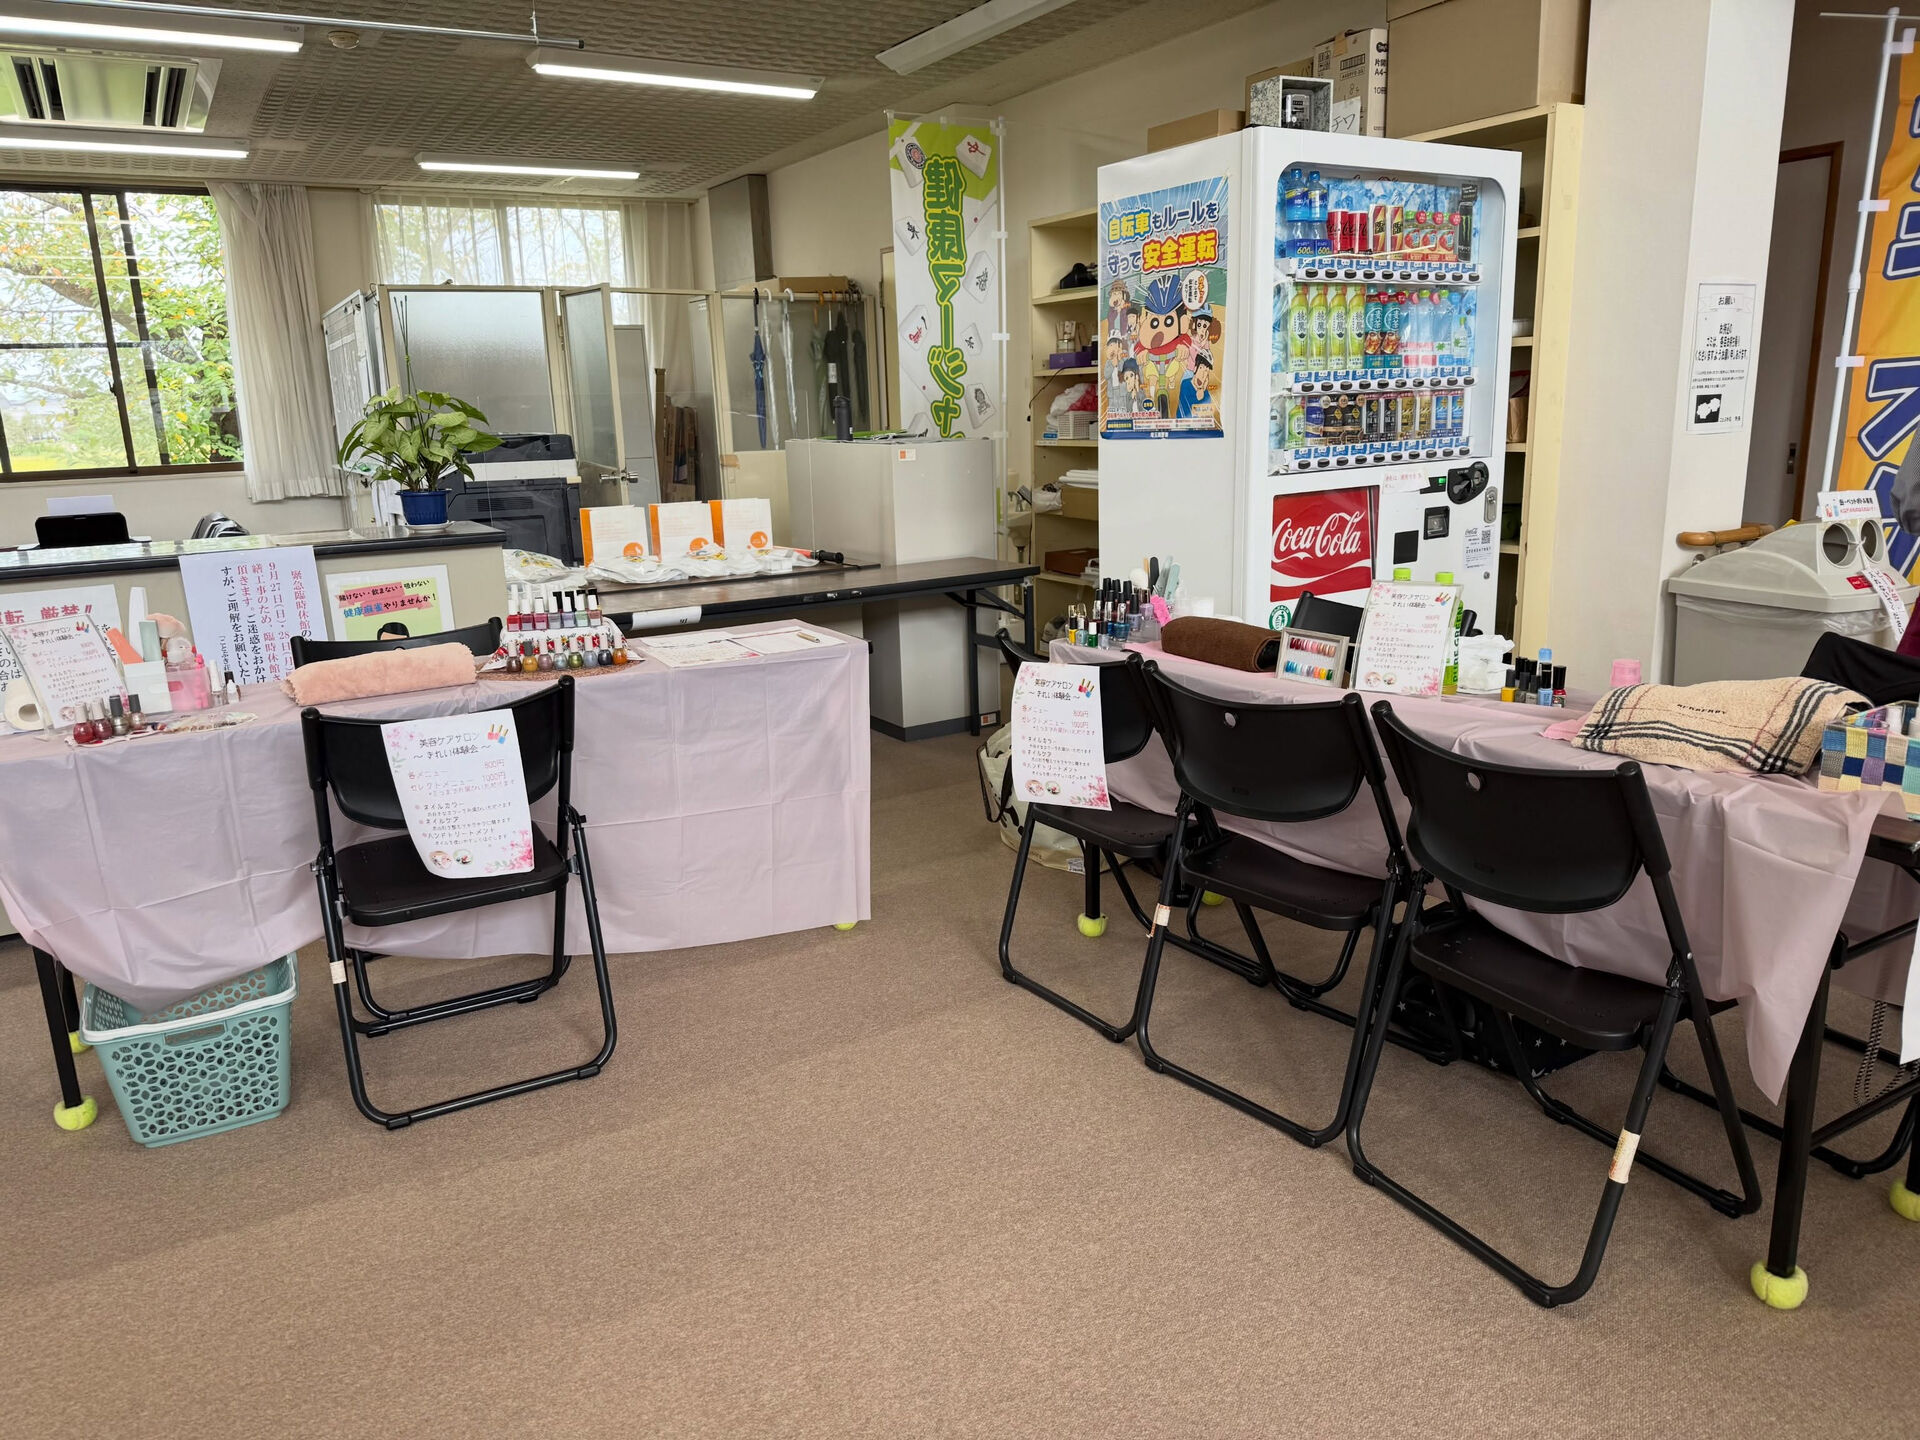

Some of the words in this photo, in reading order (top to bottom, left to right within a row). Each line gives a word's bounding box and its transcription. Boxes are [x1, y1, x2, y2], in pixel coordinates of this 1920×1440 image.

[1108, 200, 1220, 244] 自転車もルールを
[1108, 229, 1218, 275] 守って安全運転
[1273, 510, 1366, 563] Coca-Cola
[0, 610, 24, 626] 転
[419, 732, 480, 748] 美容ケアサロン
